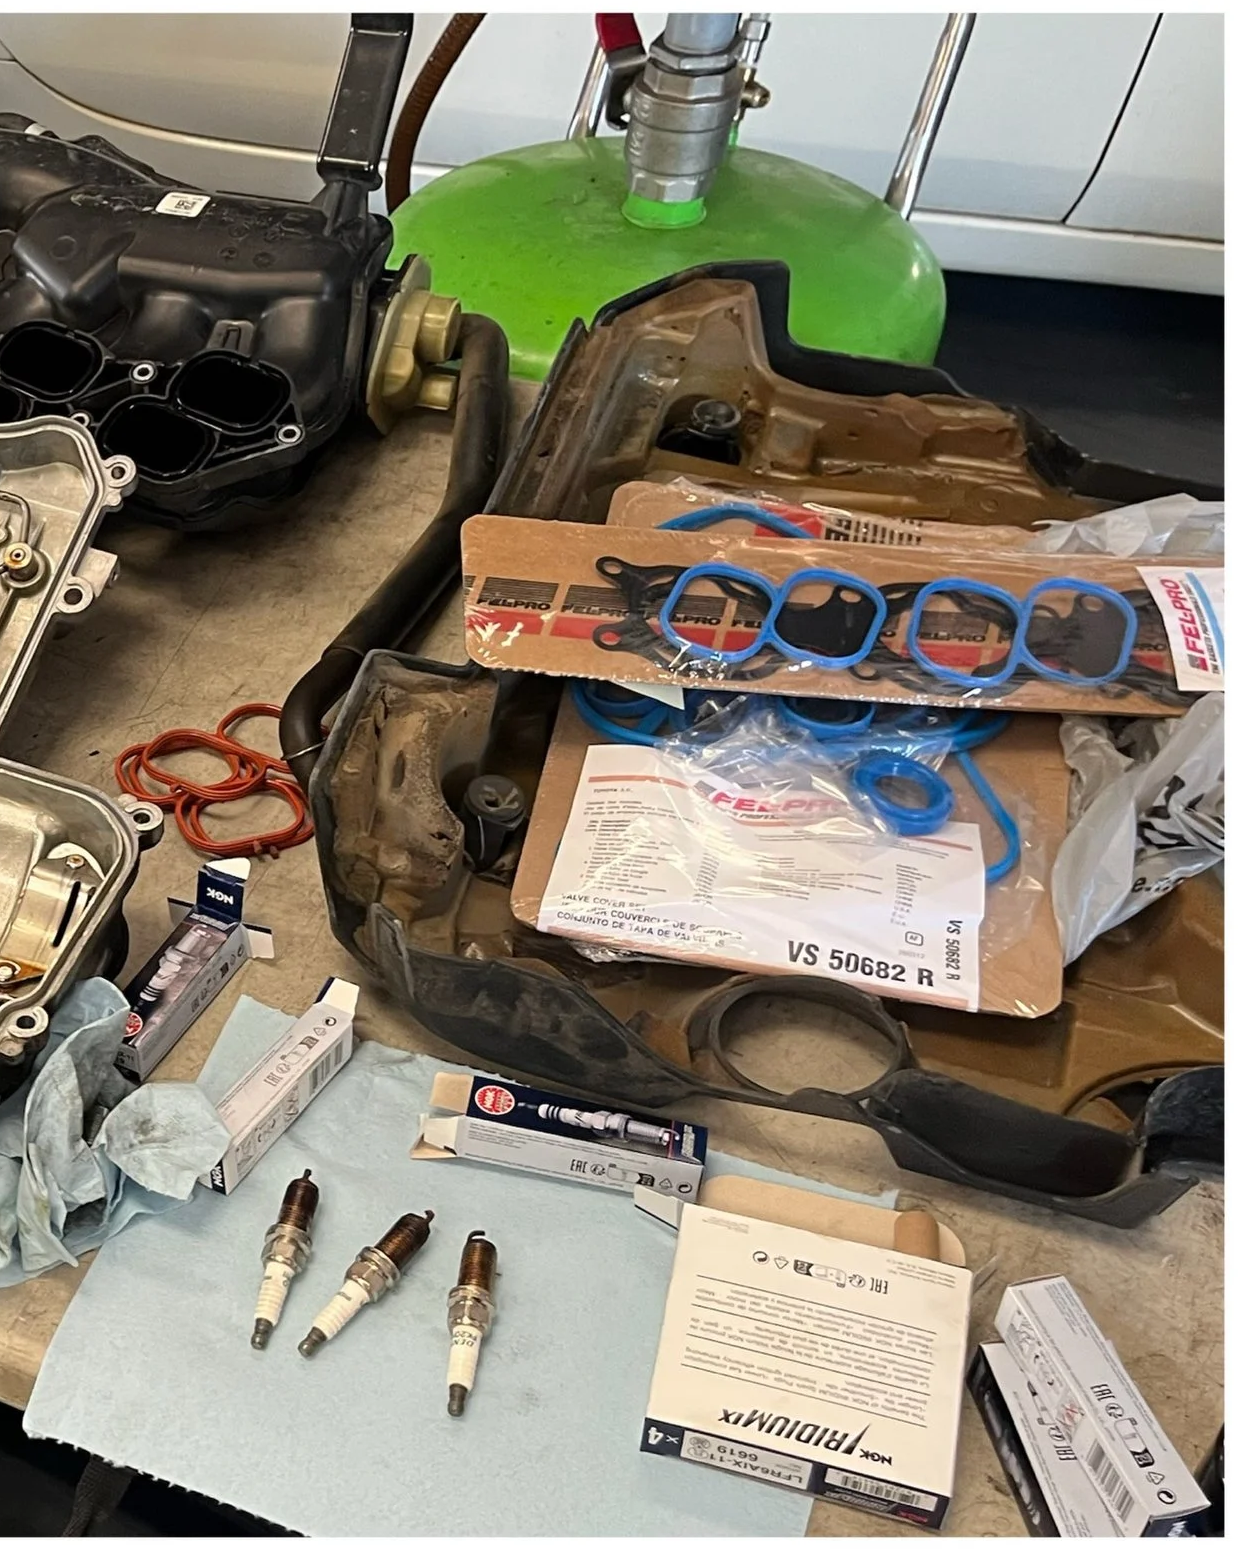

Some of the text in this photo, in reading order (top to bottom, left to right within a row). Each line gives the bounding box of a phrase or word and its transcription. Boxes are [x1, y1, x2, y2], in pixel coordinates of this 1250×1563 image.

[1160, 578, 1205, 654] FEL-PRO
[206, 886, 234, 906] NGK
[557, 911, 609, 928] CONJUNTO
[612, 920, 625, 930] DE
[657, 928, 671, 938] DE
[788, 940, 820, 966] VS
[828, 948, 907, 983] 50682
[917, 967, 935, 987] R
[945, 919, 963, 981] VS 50682 R
[717, 1408, 893, 1466] NGK IRIDIUM IX
[717, 1445, 759, 1463] 6619
[709, 1452, 804, 1484] LFR6AIX-11
